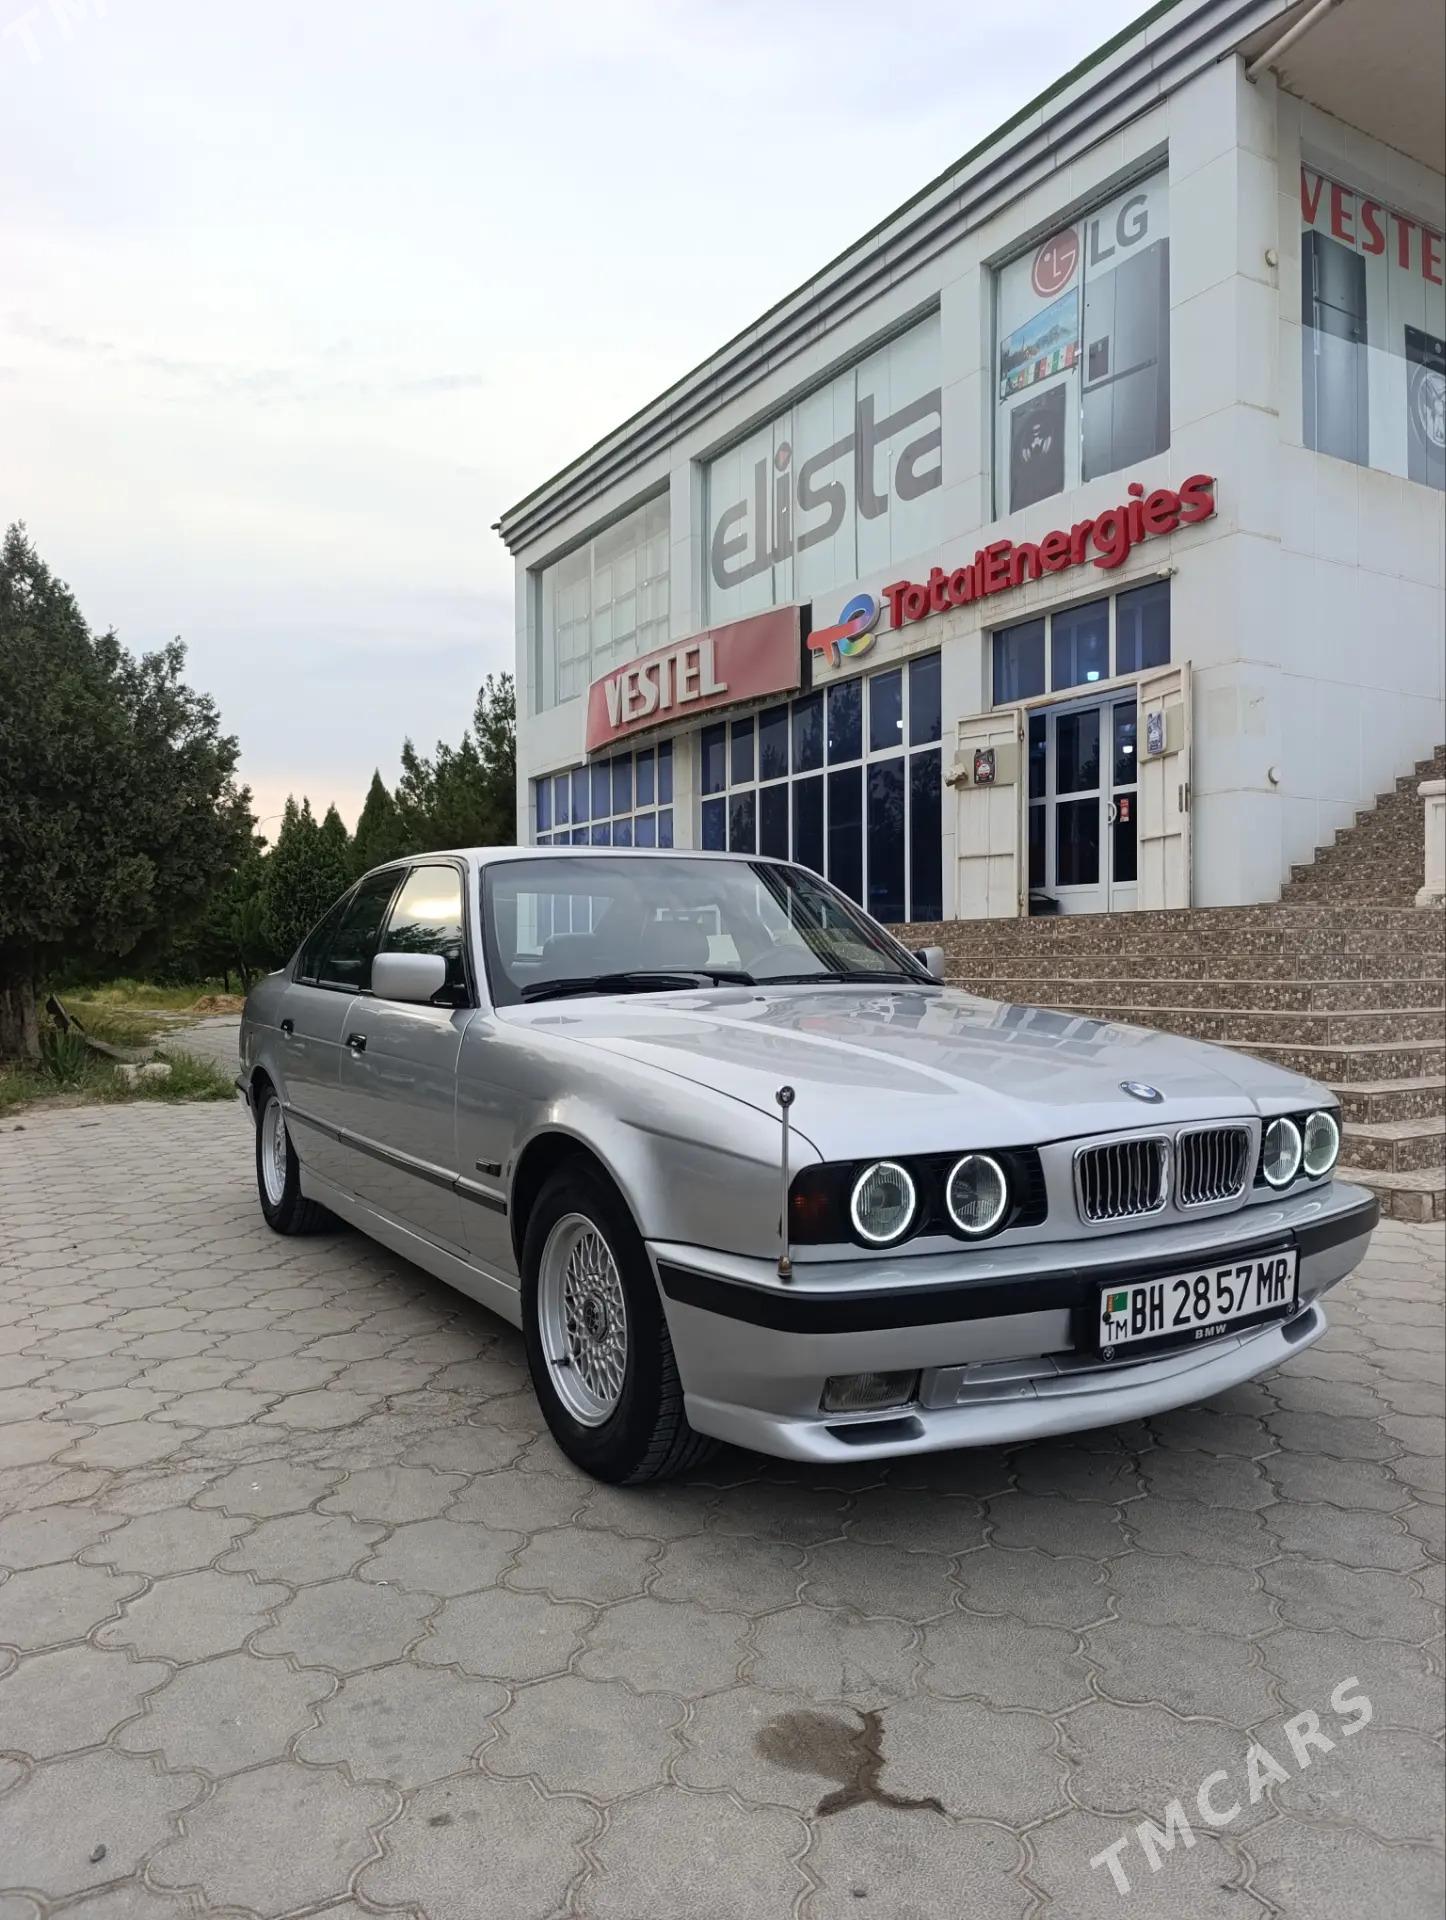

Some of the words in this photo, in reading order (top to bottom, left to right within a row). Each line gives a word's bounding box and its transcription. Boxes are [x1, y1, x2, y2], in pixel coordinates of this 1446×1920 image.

[1089, 193, 1148, 267] LG
[710, 387, 942, 590] elista
[881, 474, 1216, 629] TotalEnergies
[604, 639, 728, 728] VESTEL
[1105, 1318, 1128, 1341] TM
[1131, 1284, 1164, 1335] BH
[1256, 1258, 1288, 1306] MR
[1195, 1323, 1227, 1339] BMW
